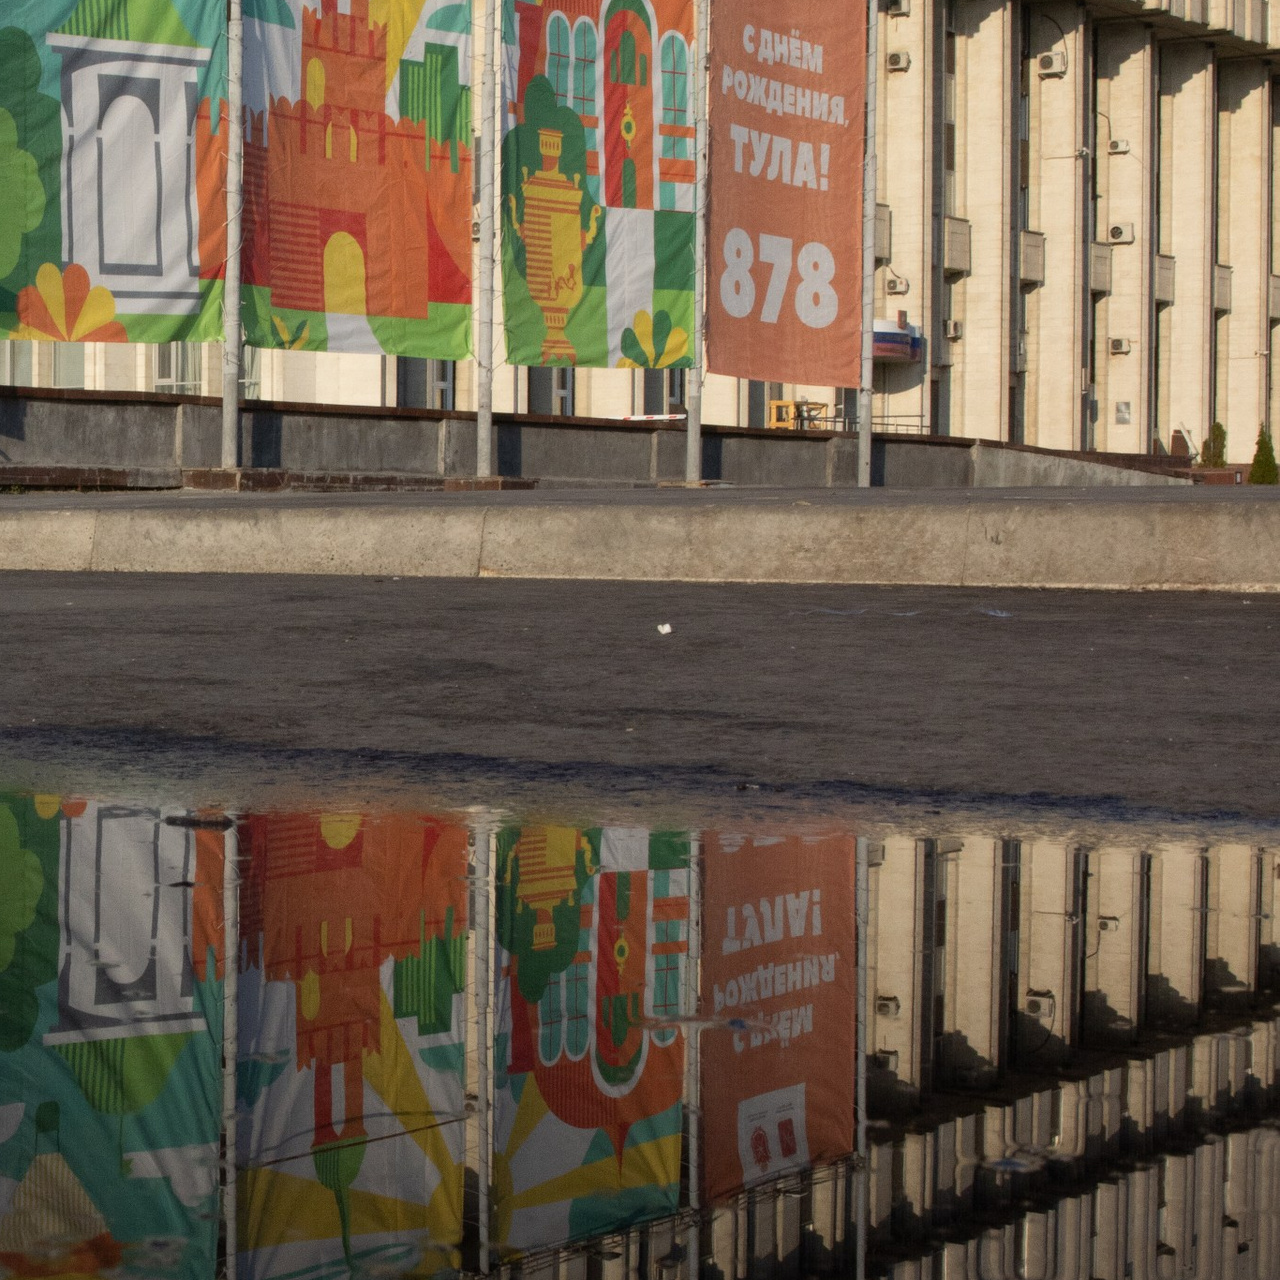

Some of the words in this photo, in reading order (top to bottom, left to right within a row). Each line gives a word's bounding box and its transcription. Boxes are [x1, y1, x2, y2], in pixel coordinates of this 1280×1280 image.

[742, 24, 756, 54] С
[757, 28, 824, 74] ДНЁМ
[721, 65, 850, 128] РОЖДЕНИЯ,
[729, 124, 831, 192] ТУЛА!
[719, 227, 839, 329] 878
